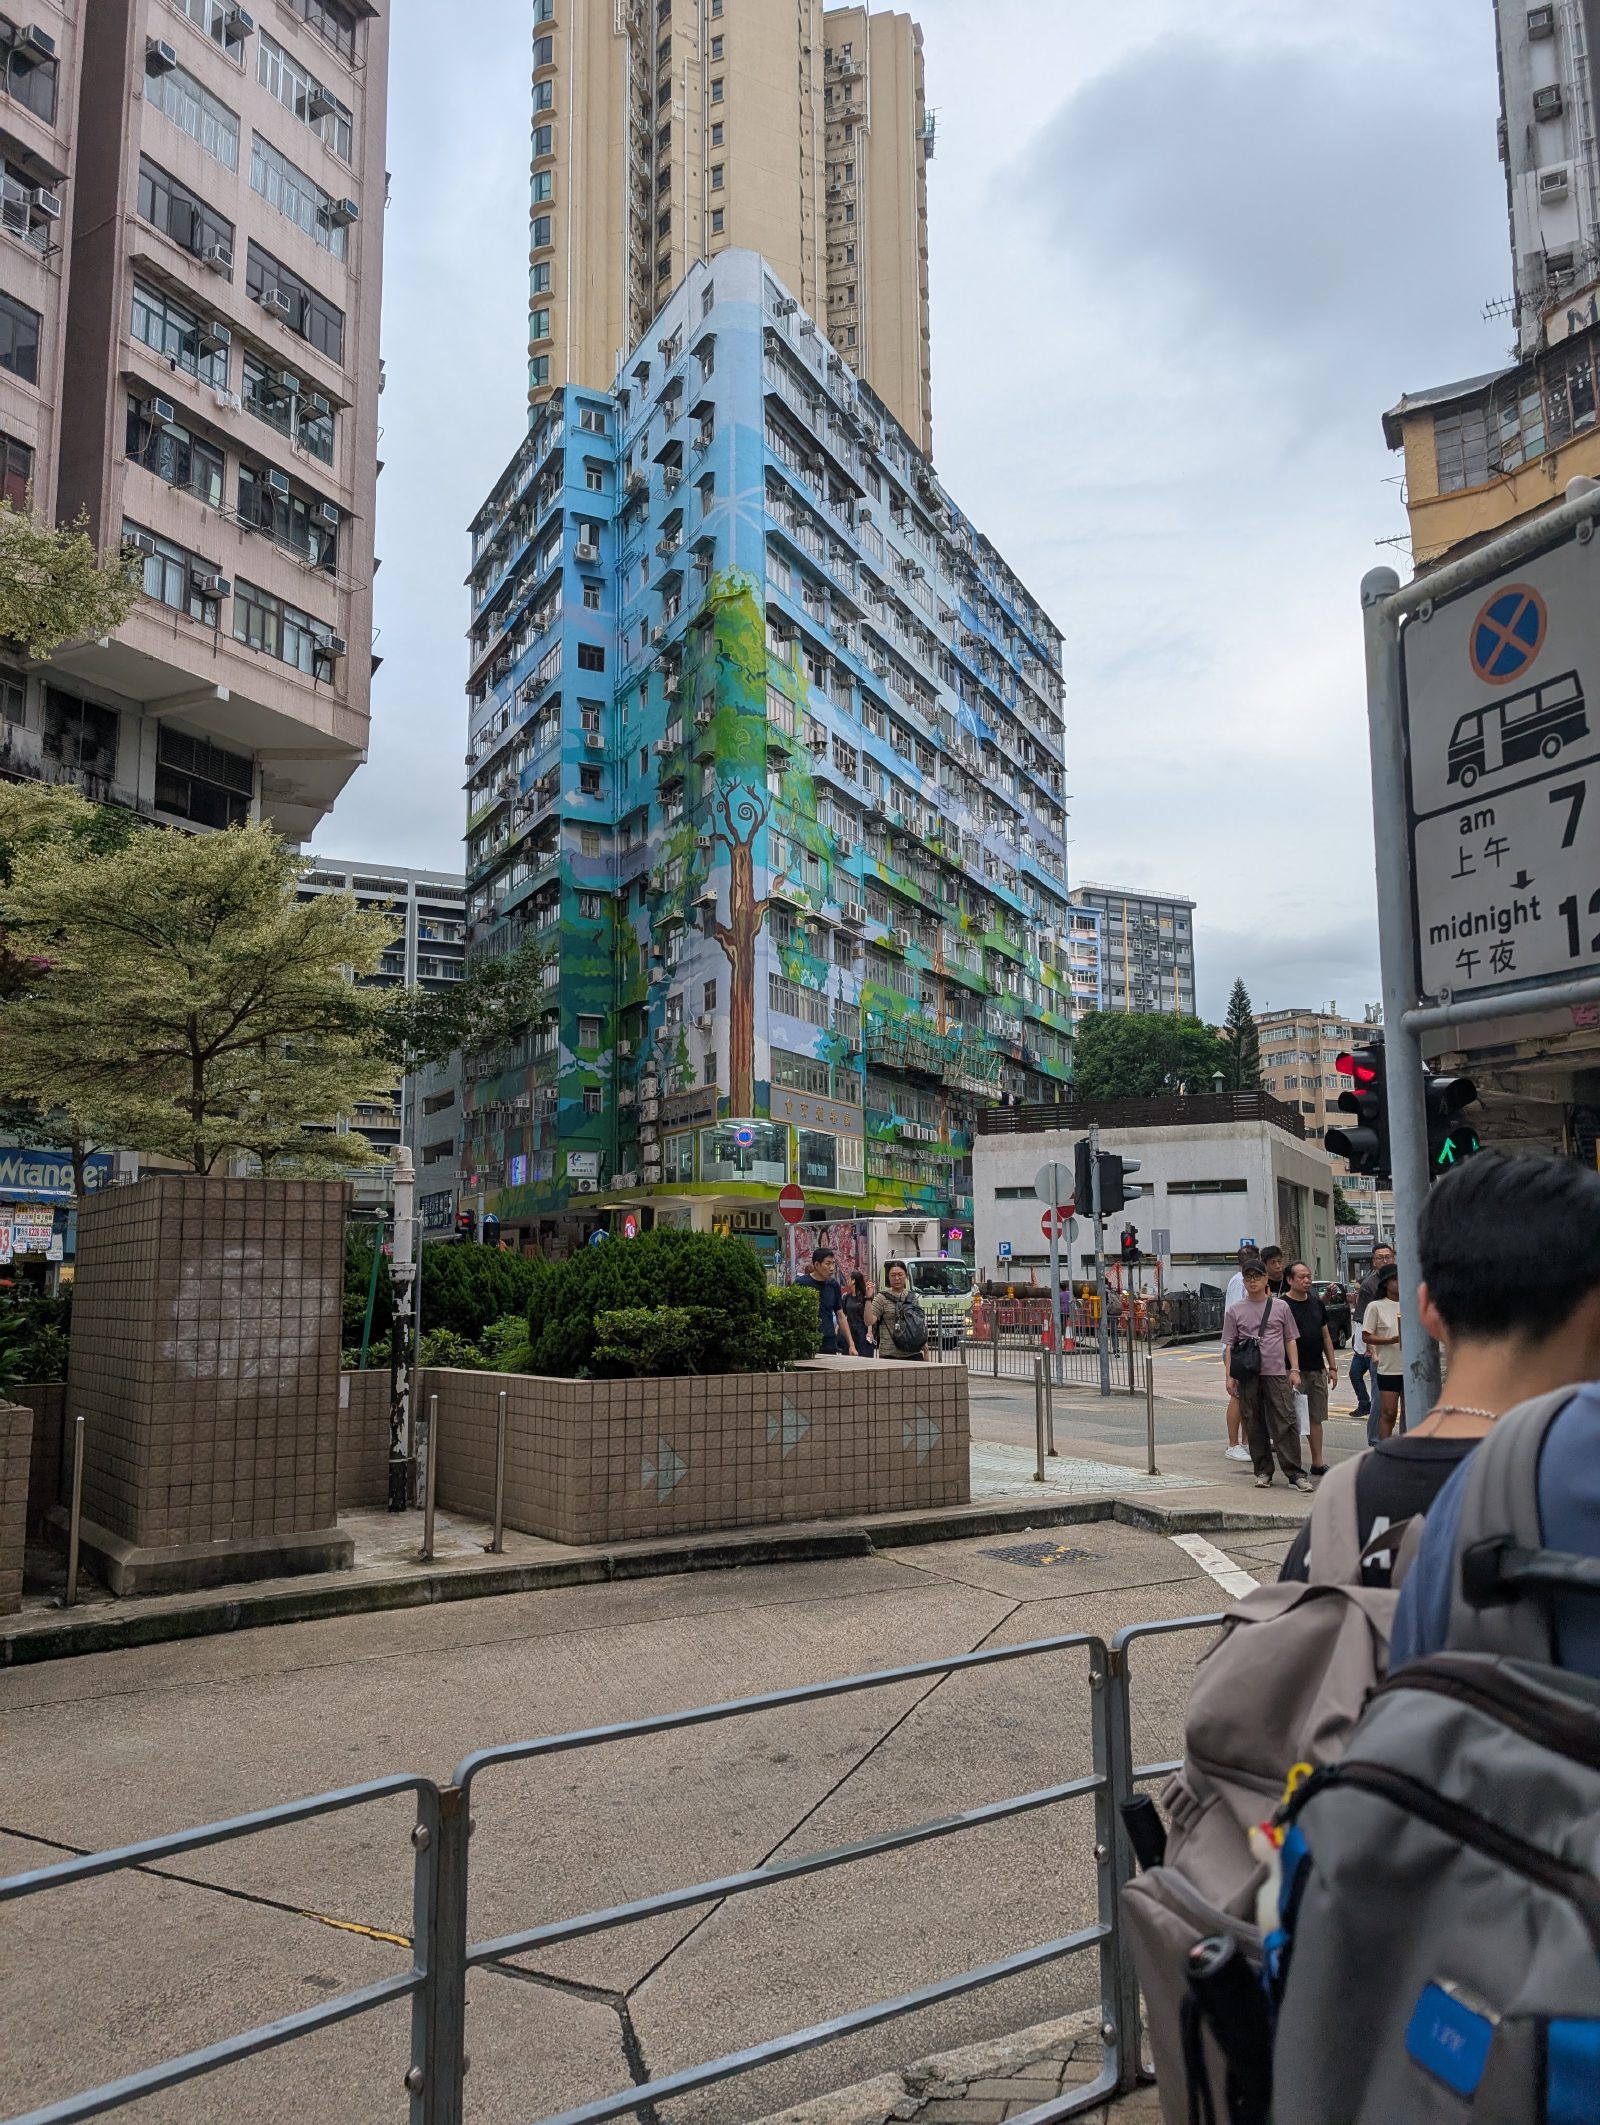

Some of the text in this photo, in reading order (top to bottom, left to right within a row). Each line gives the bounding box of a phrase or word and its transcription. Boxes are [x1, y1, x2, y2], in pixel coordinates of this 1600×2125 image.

[1459, 780, 1586, 849] am 7
[1451, 837, 1511, 879] 上午
[1430, 895, 1542, 945] midnight
[1456, 939, 1517, 980] 午夜
[0, 1156, 108, 1195] Wranger
[1001, 1244, 1010, 1255] P
